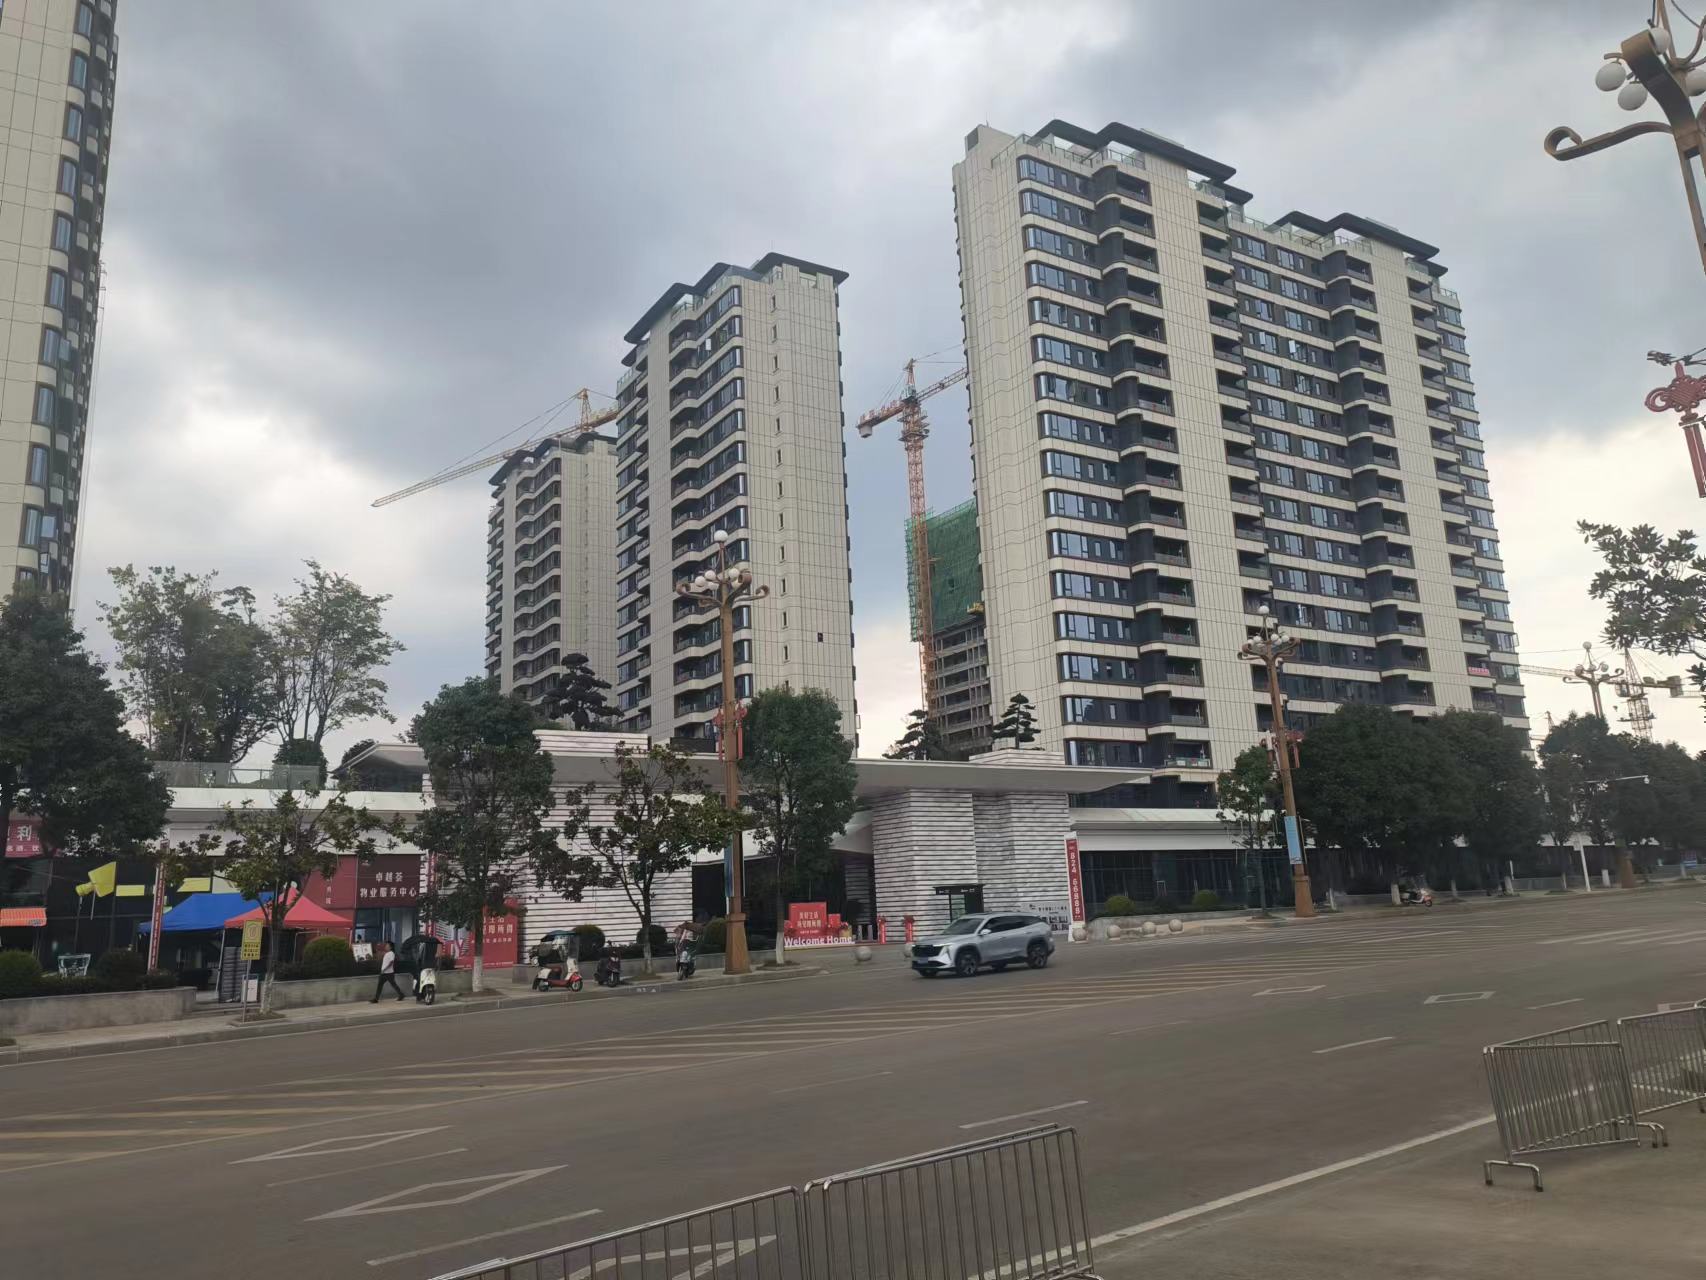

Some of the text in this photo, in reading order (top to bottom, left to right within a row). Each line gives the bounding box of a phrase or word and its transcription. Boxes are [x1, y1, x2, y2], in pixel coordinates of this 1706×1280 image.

[359, 887, 417, 898] 物业服务中心
[784, 936, 825, 947] Welcome
